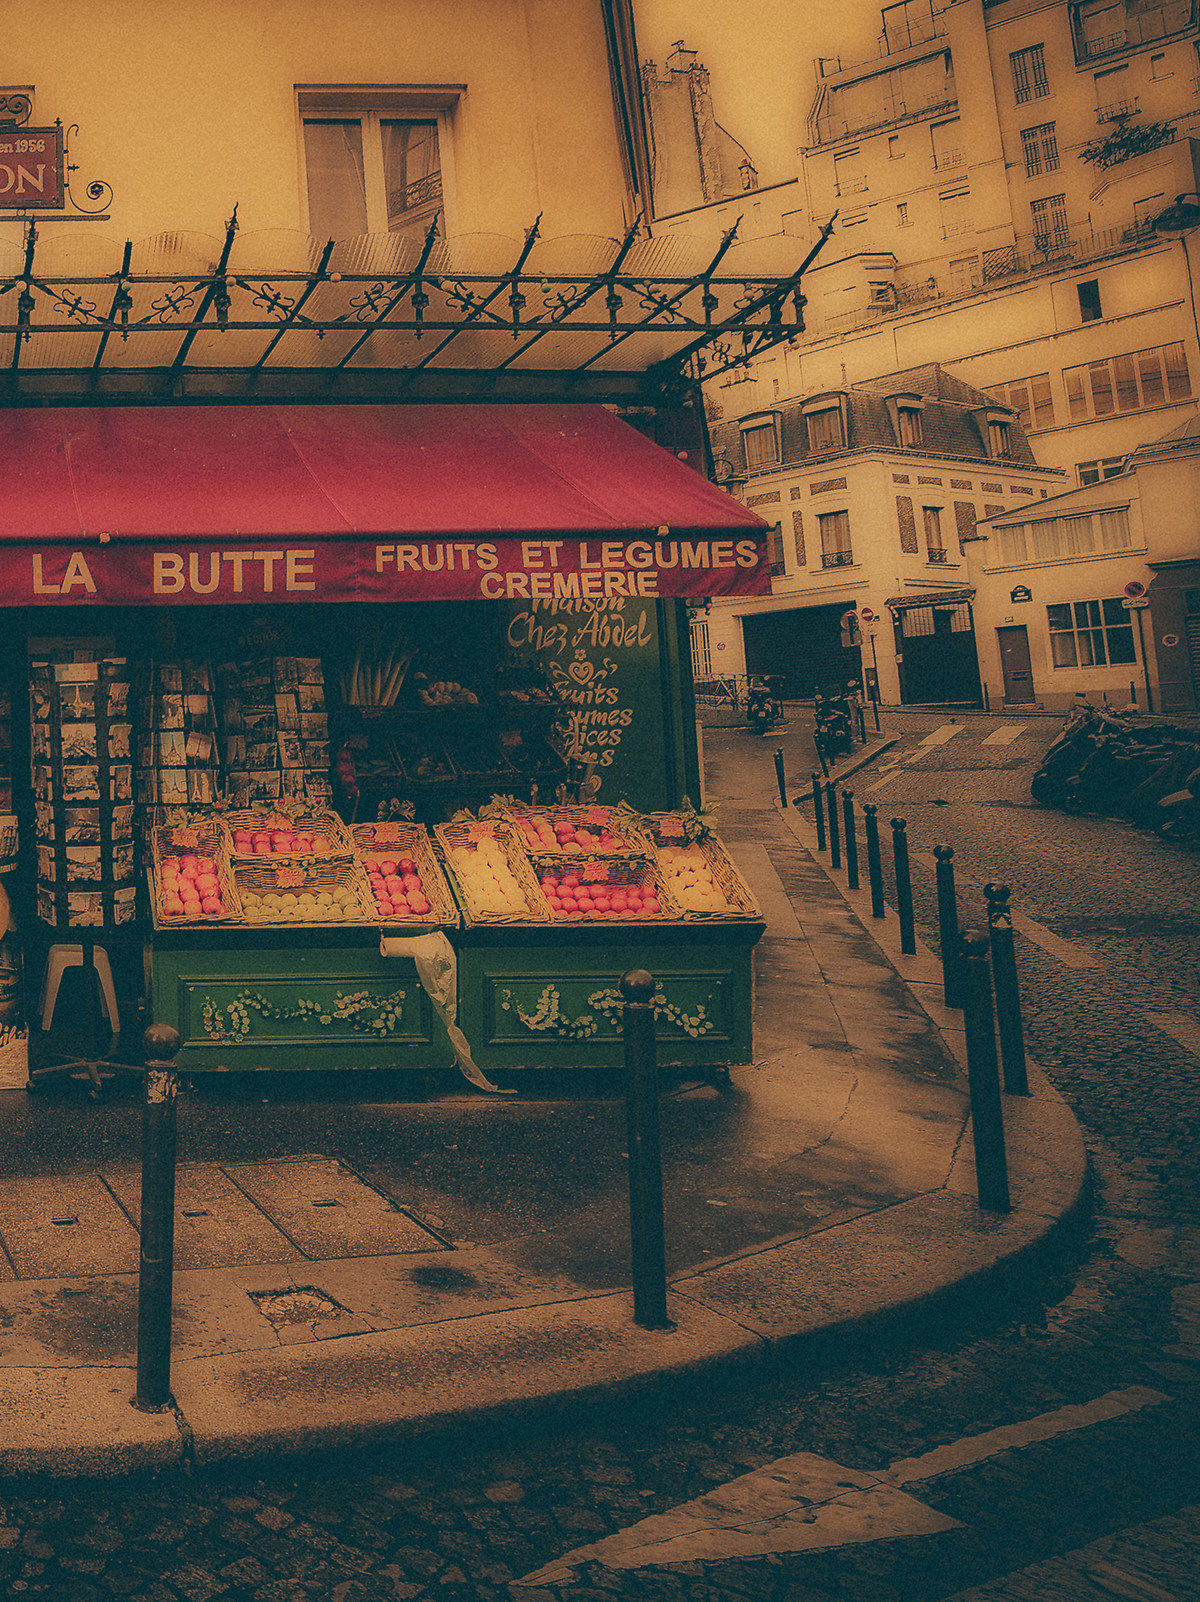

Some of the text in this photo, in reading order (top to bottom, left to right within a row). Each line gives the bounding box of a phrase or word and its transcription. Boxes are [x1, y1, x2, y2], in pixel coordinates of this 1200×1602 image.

[14, 139, 46, 153] 1956
[32, 552, 97, 594] LA
[153, 549, 316, 594] BUTTE
[375, 541, 759, 572] FRUITS ET LEGUMES
[479, 571, 660, 599] CREMERIE
[506, 610, 652, 656] Chez Abdel
